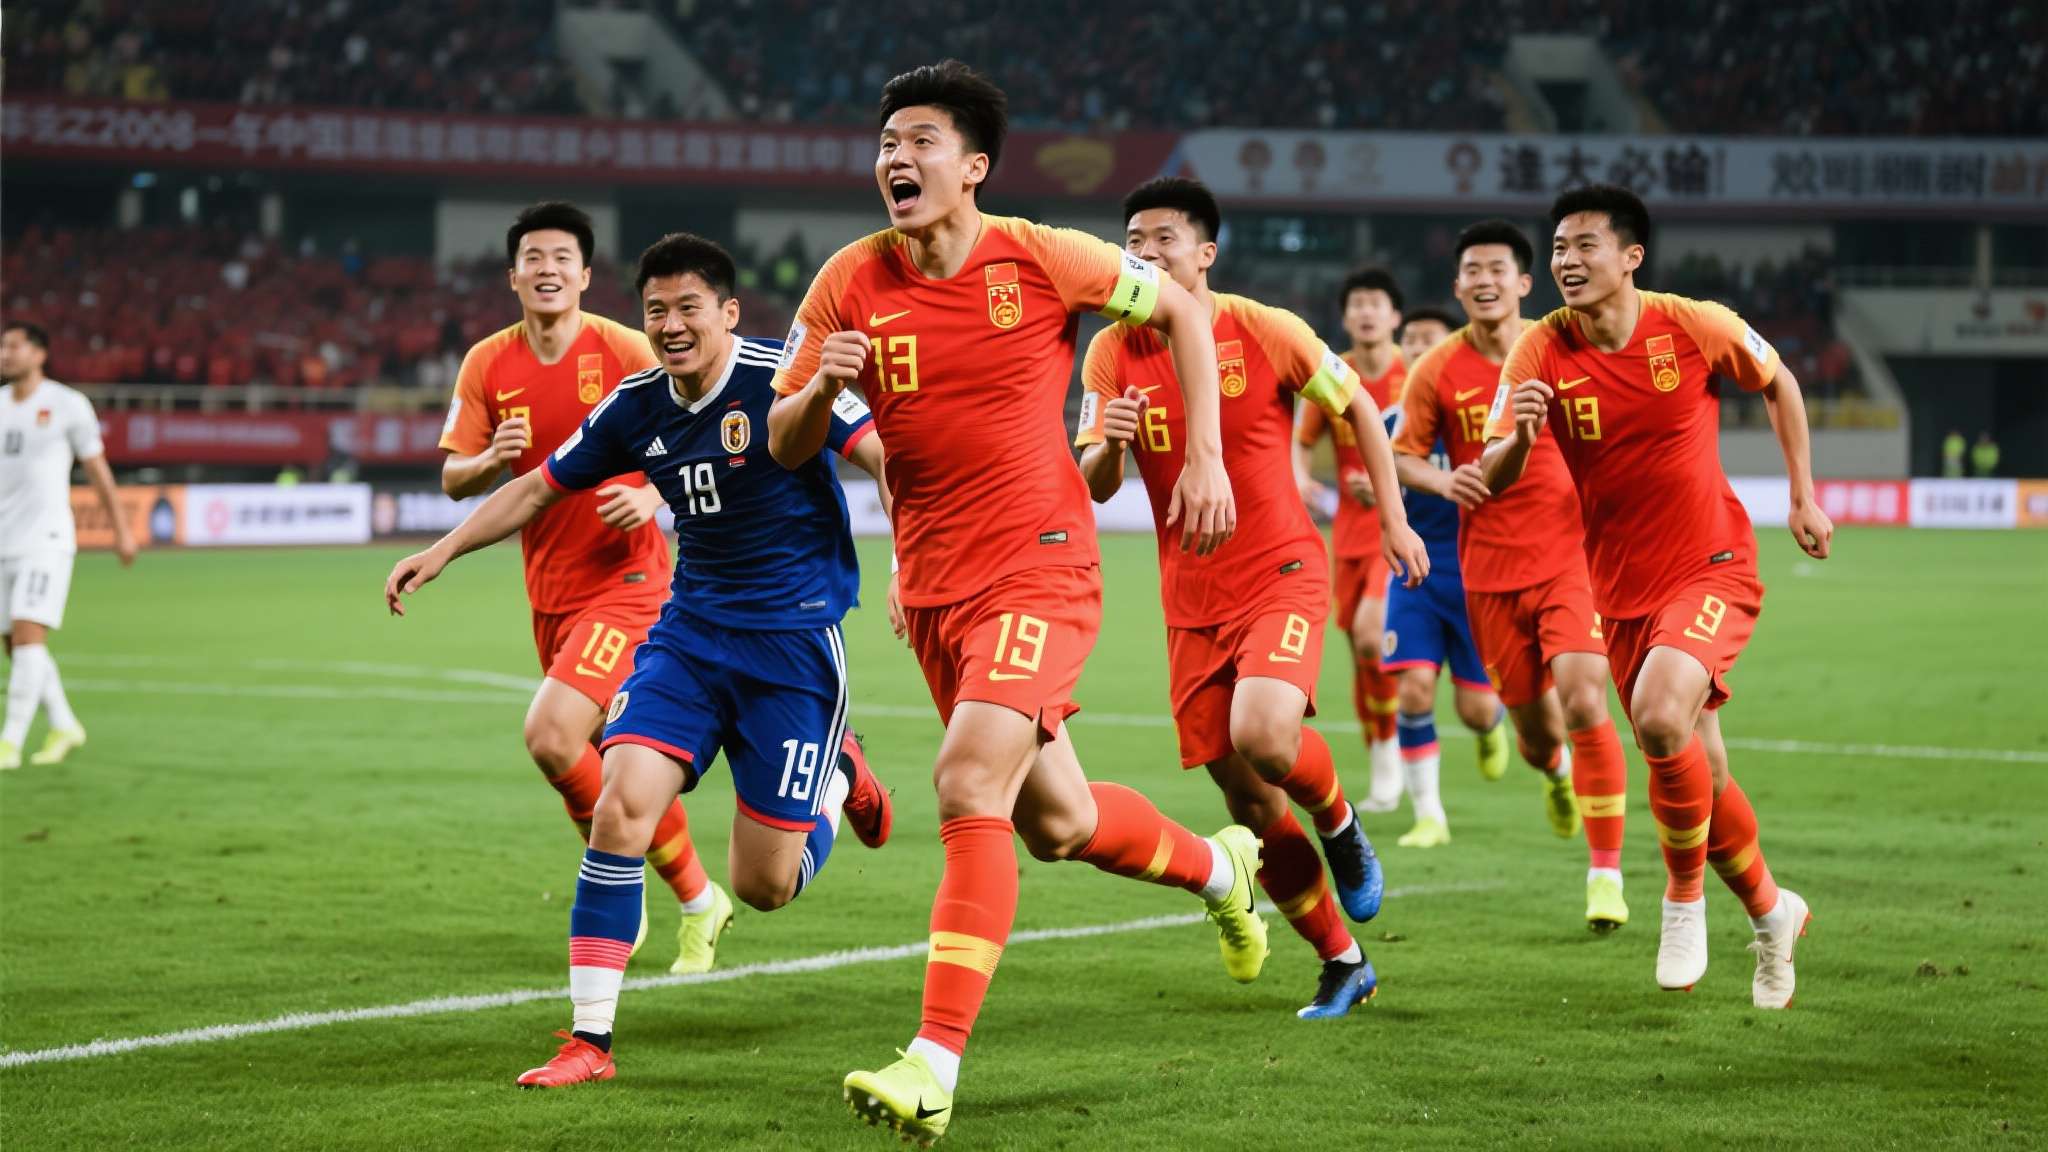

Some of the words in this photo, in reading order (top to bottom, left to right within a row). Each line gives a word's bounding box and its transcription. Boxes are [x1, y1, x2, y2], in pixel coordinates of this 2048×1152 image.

[679, 463, 722, 515] 19
[1281, 614, 1310, 656] 8
[1694, 594, 1727, 637] 9
[581, 622, 629, 673] 18
[993, 613, 1049, 673] 19
[777, 739, 819, 800] 19
